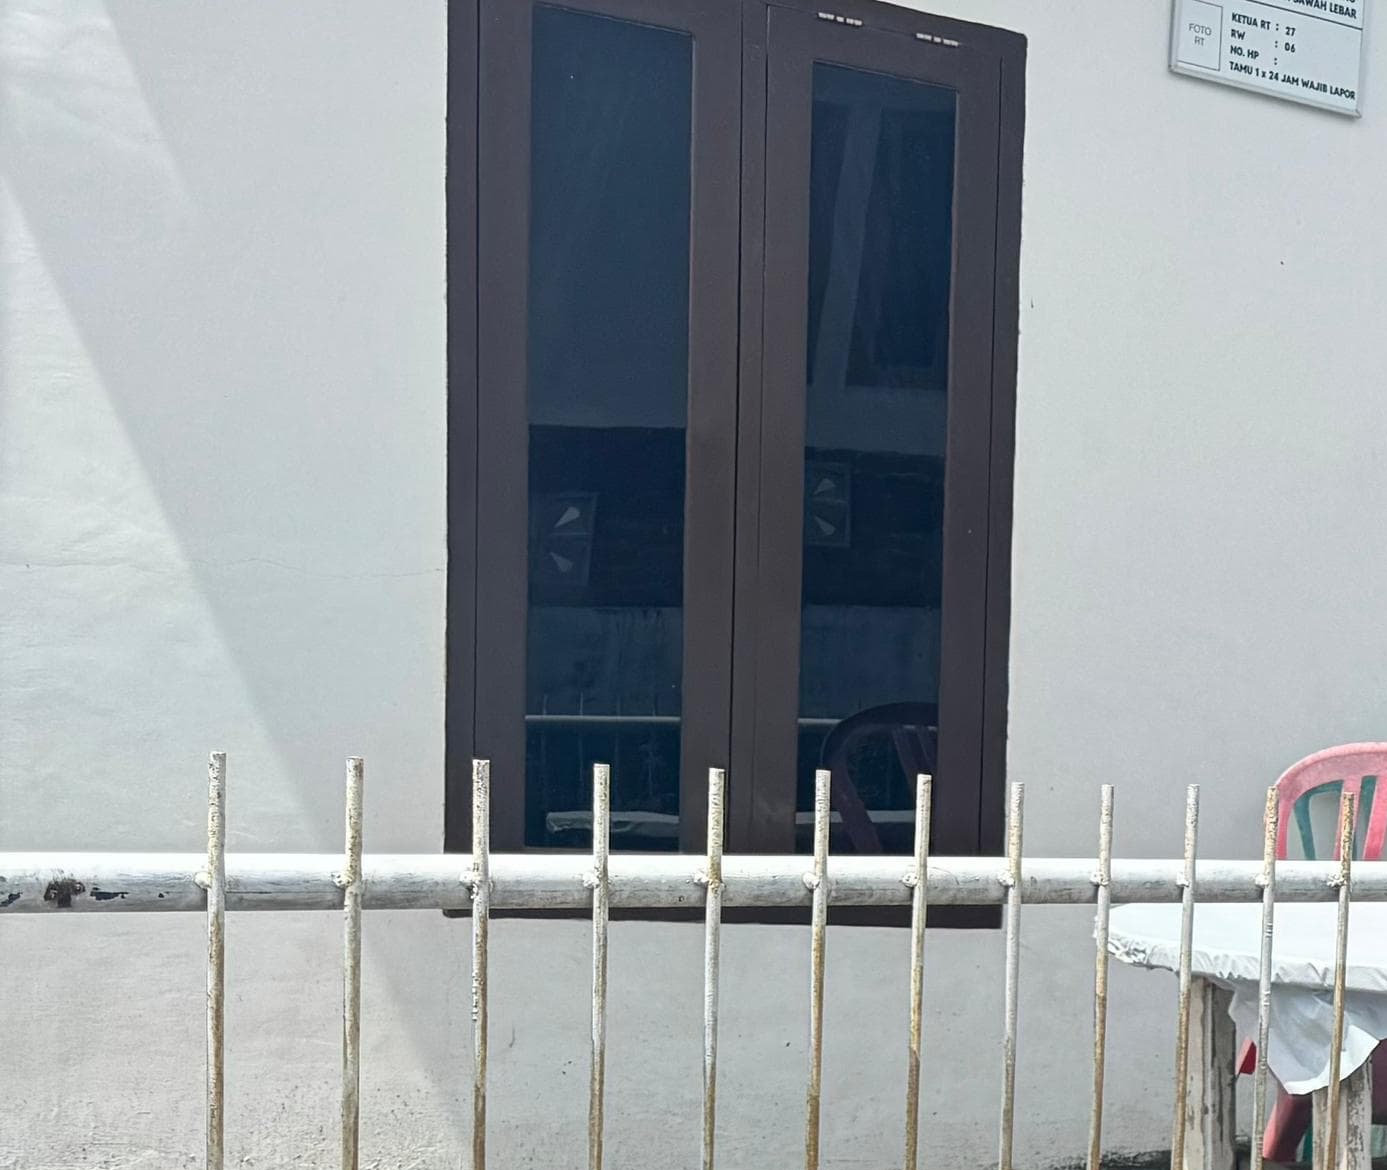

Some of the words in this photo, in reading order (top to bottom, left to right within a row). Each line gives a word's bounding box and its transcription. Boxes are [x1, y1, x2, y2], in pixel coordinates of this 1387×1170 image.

[1329, 2, 1357, 20] LEBAR
[1188, 23, 1212, 36] FOTO
[1231, 12, 1258, 28] KETUA
[1260, 19, 1271, 31] RT
[1285, 26, 1296, 37] 27
[1194, 35, 1205, 47] RT
[1230, 29, 1246, 41] RW
[1284, 42, 1296, 53] 06
[1230, 45, 1246, 57] NO.
[1247, 48, 1260, 60] HP
[1229, 61, 1253, 76] TAMU
[1255, 68, 1259, 77] 1
[1269, 70, 1279, 81] 24
[1281, 74, 1299, 87] JAM
[1301, 78, 1328, 93] WAJIB
[1329, 85, 1356, 100] LAPOR
